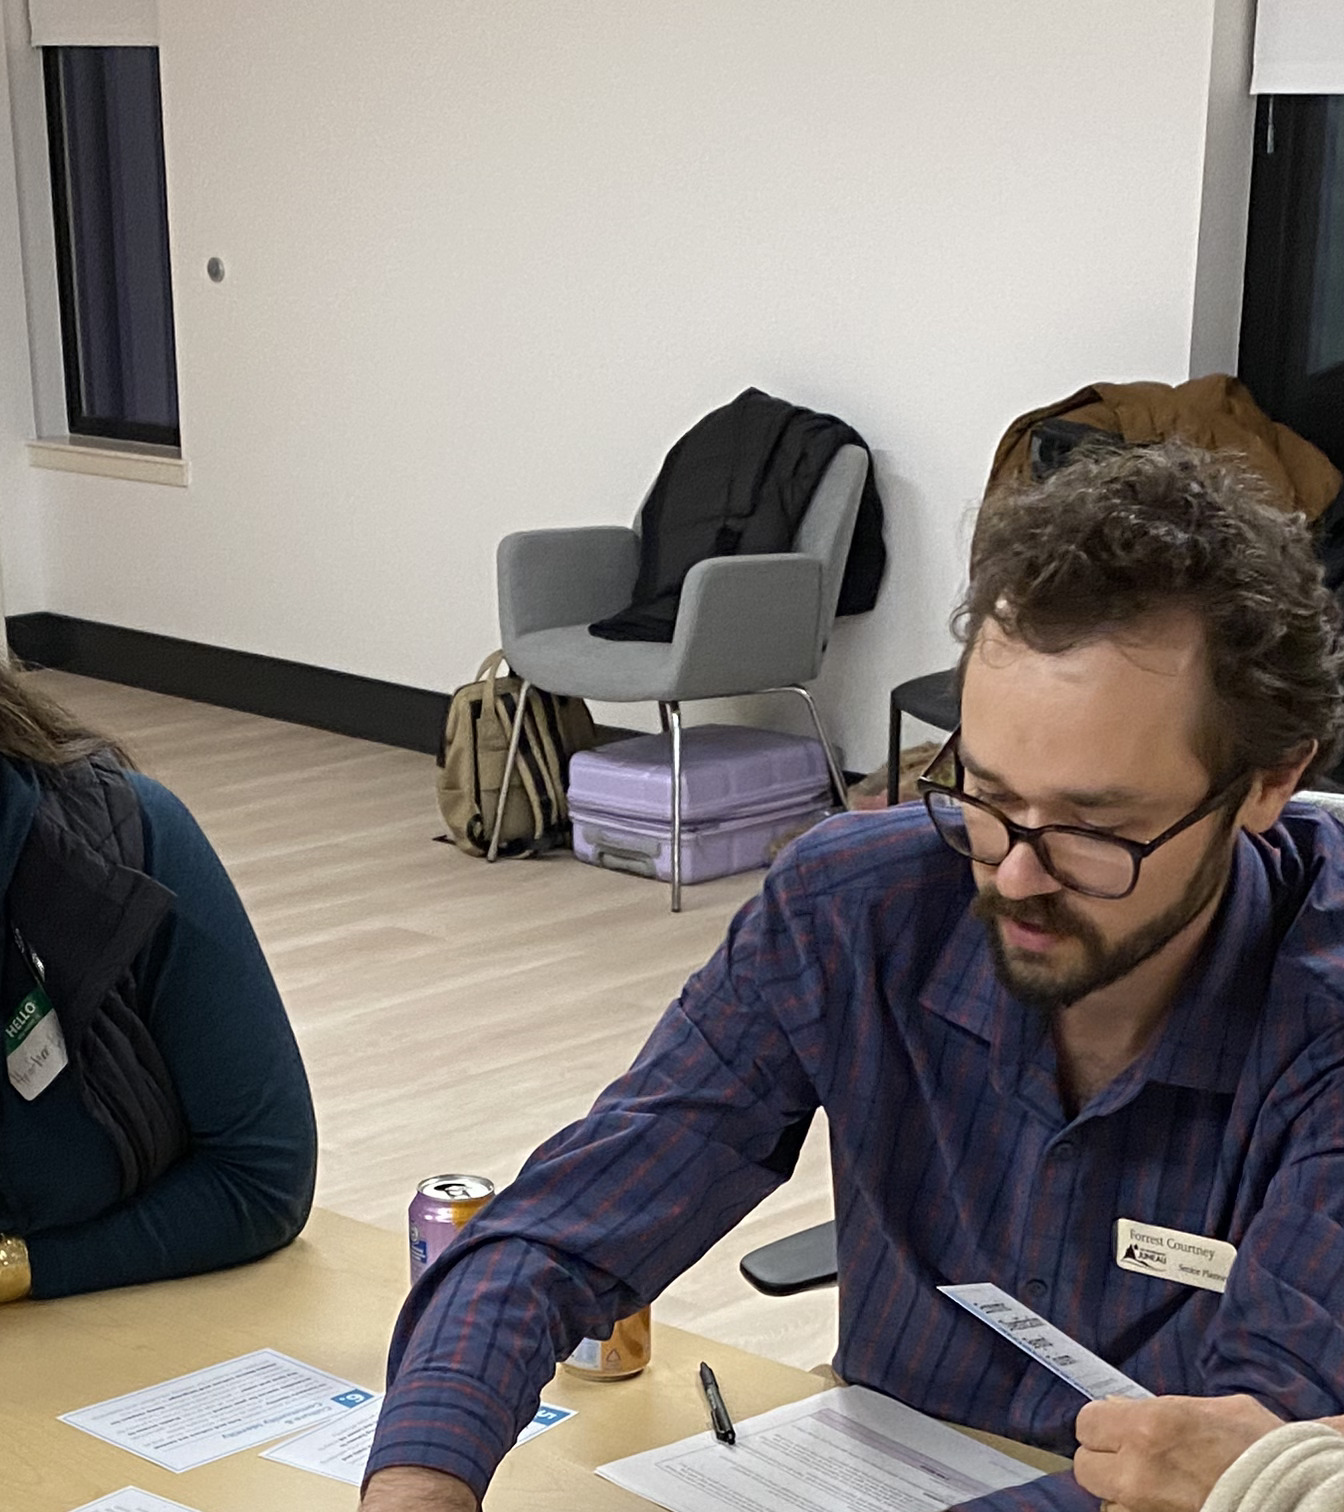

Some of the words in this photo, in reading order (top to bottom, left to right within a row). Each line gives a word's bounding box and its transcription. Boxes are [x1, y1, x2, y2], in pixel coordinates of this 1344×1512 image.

[5, 1002, 36, 1038] HELLO
[1130, 1229, 1164, 1247] Forrest
[1167, 1238, 1215, 1261] Courtney
